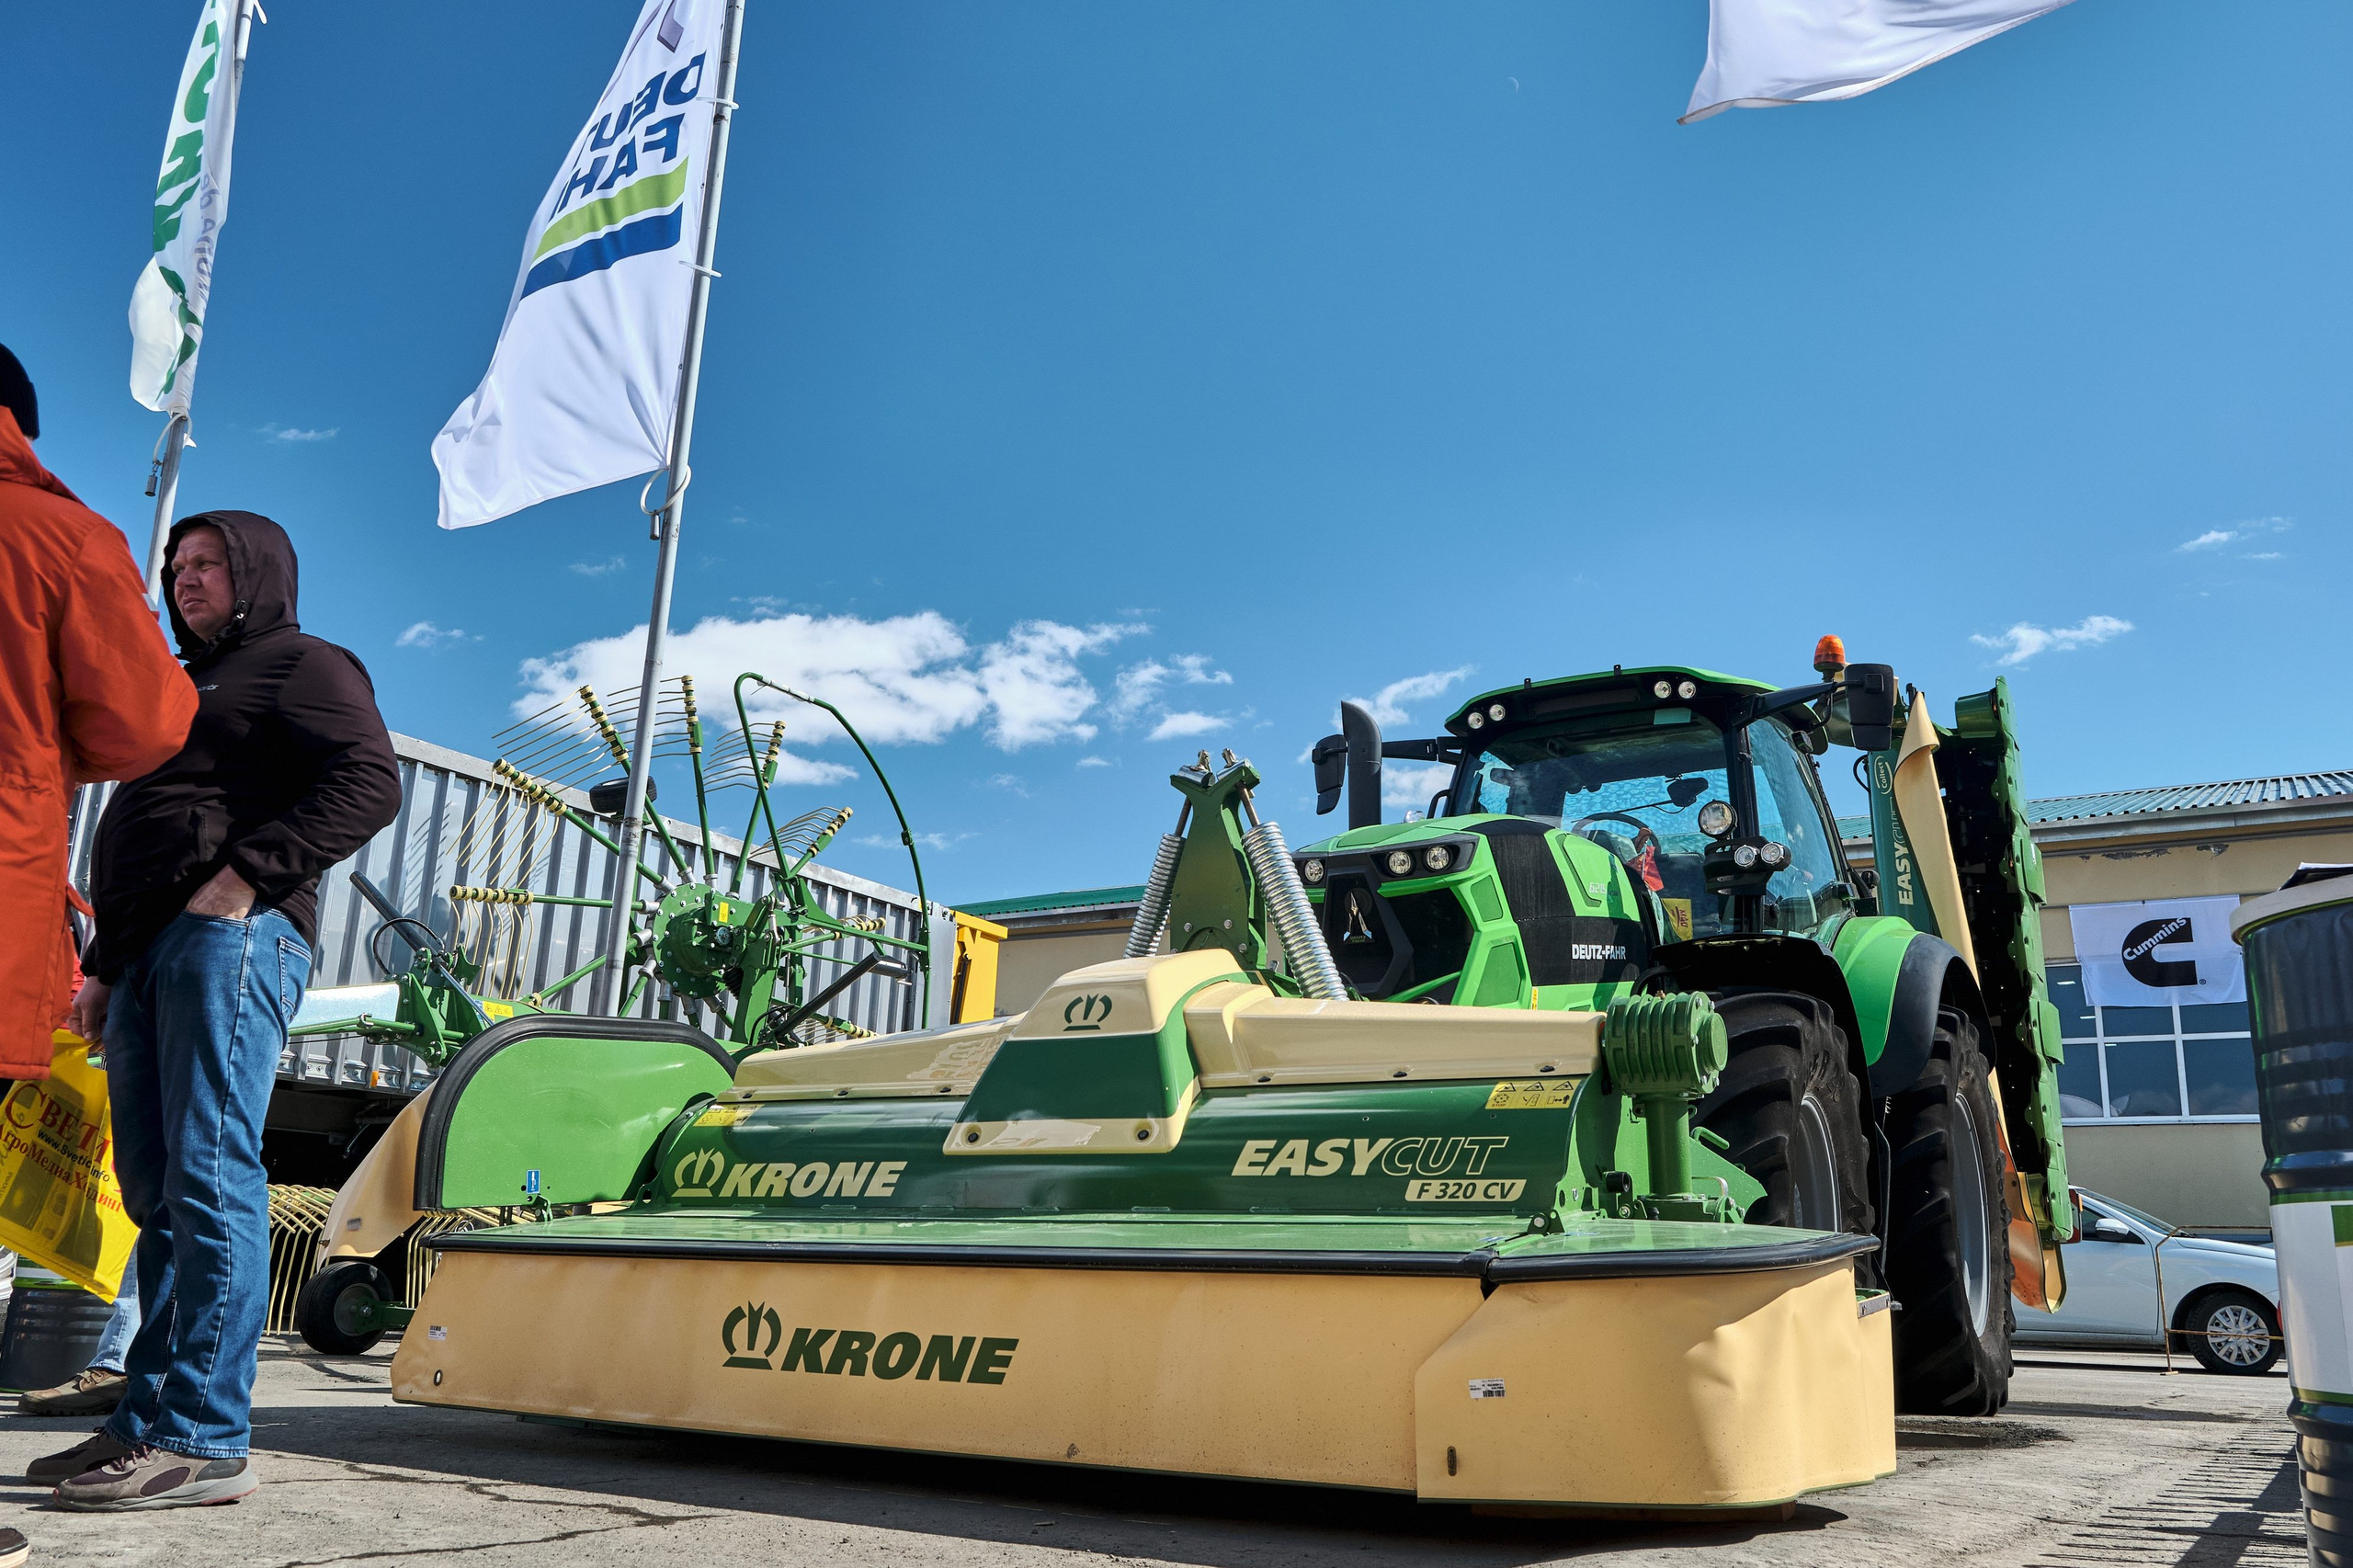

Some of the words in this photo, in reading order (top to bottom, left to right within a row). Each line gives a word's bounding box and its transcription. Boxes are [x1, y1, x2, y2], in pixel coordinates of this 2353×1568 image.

[1572, 943, 1626, 960] DEUTZ-FAHR
[2122, 917, 2188, 960] Cummins
[37, 1129, 110, 1183] www.Sveticinfo
[1232, 1137, 1509, 1176] EASYCUT
[719, 1161, 908, 1198] KRONE
[1416, 1182, 1433, 1199] F
[1435, 1182, 1476, 1199] 320
[1483, 1182, 1517, 1199] CV
[780, 1327, 1019, 1385] KRONE
